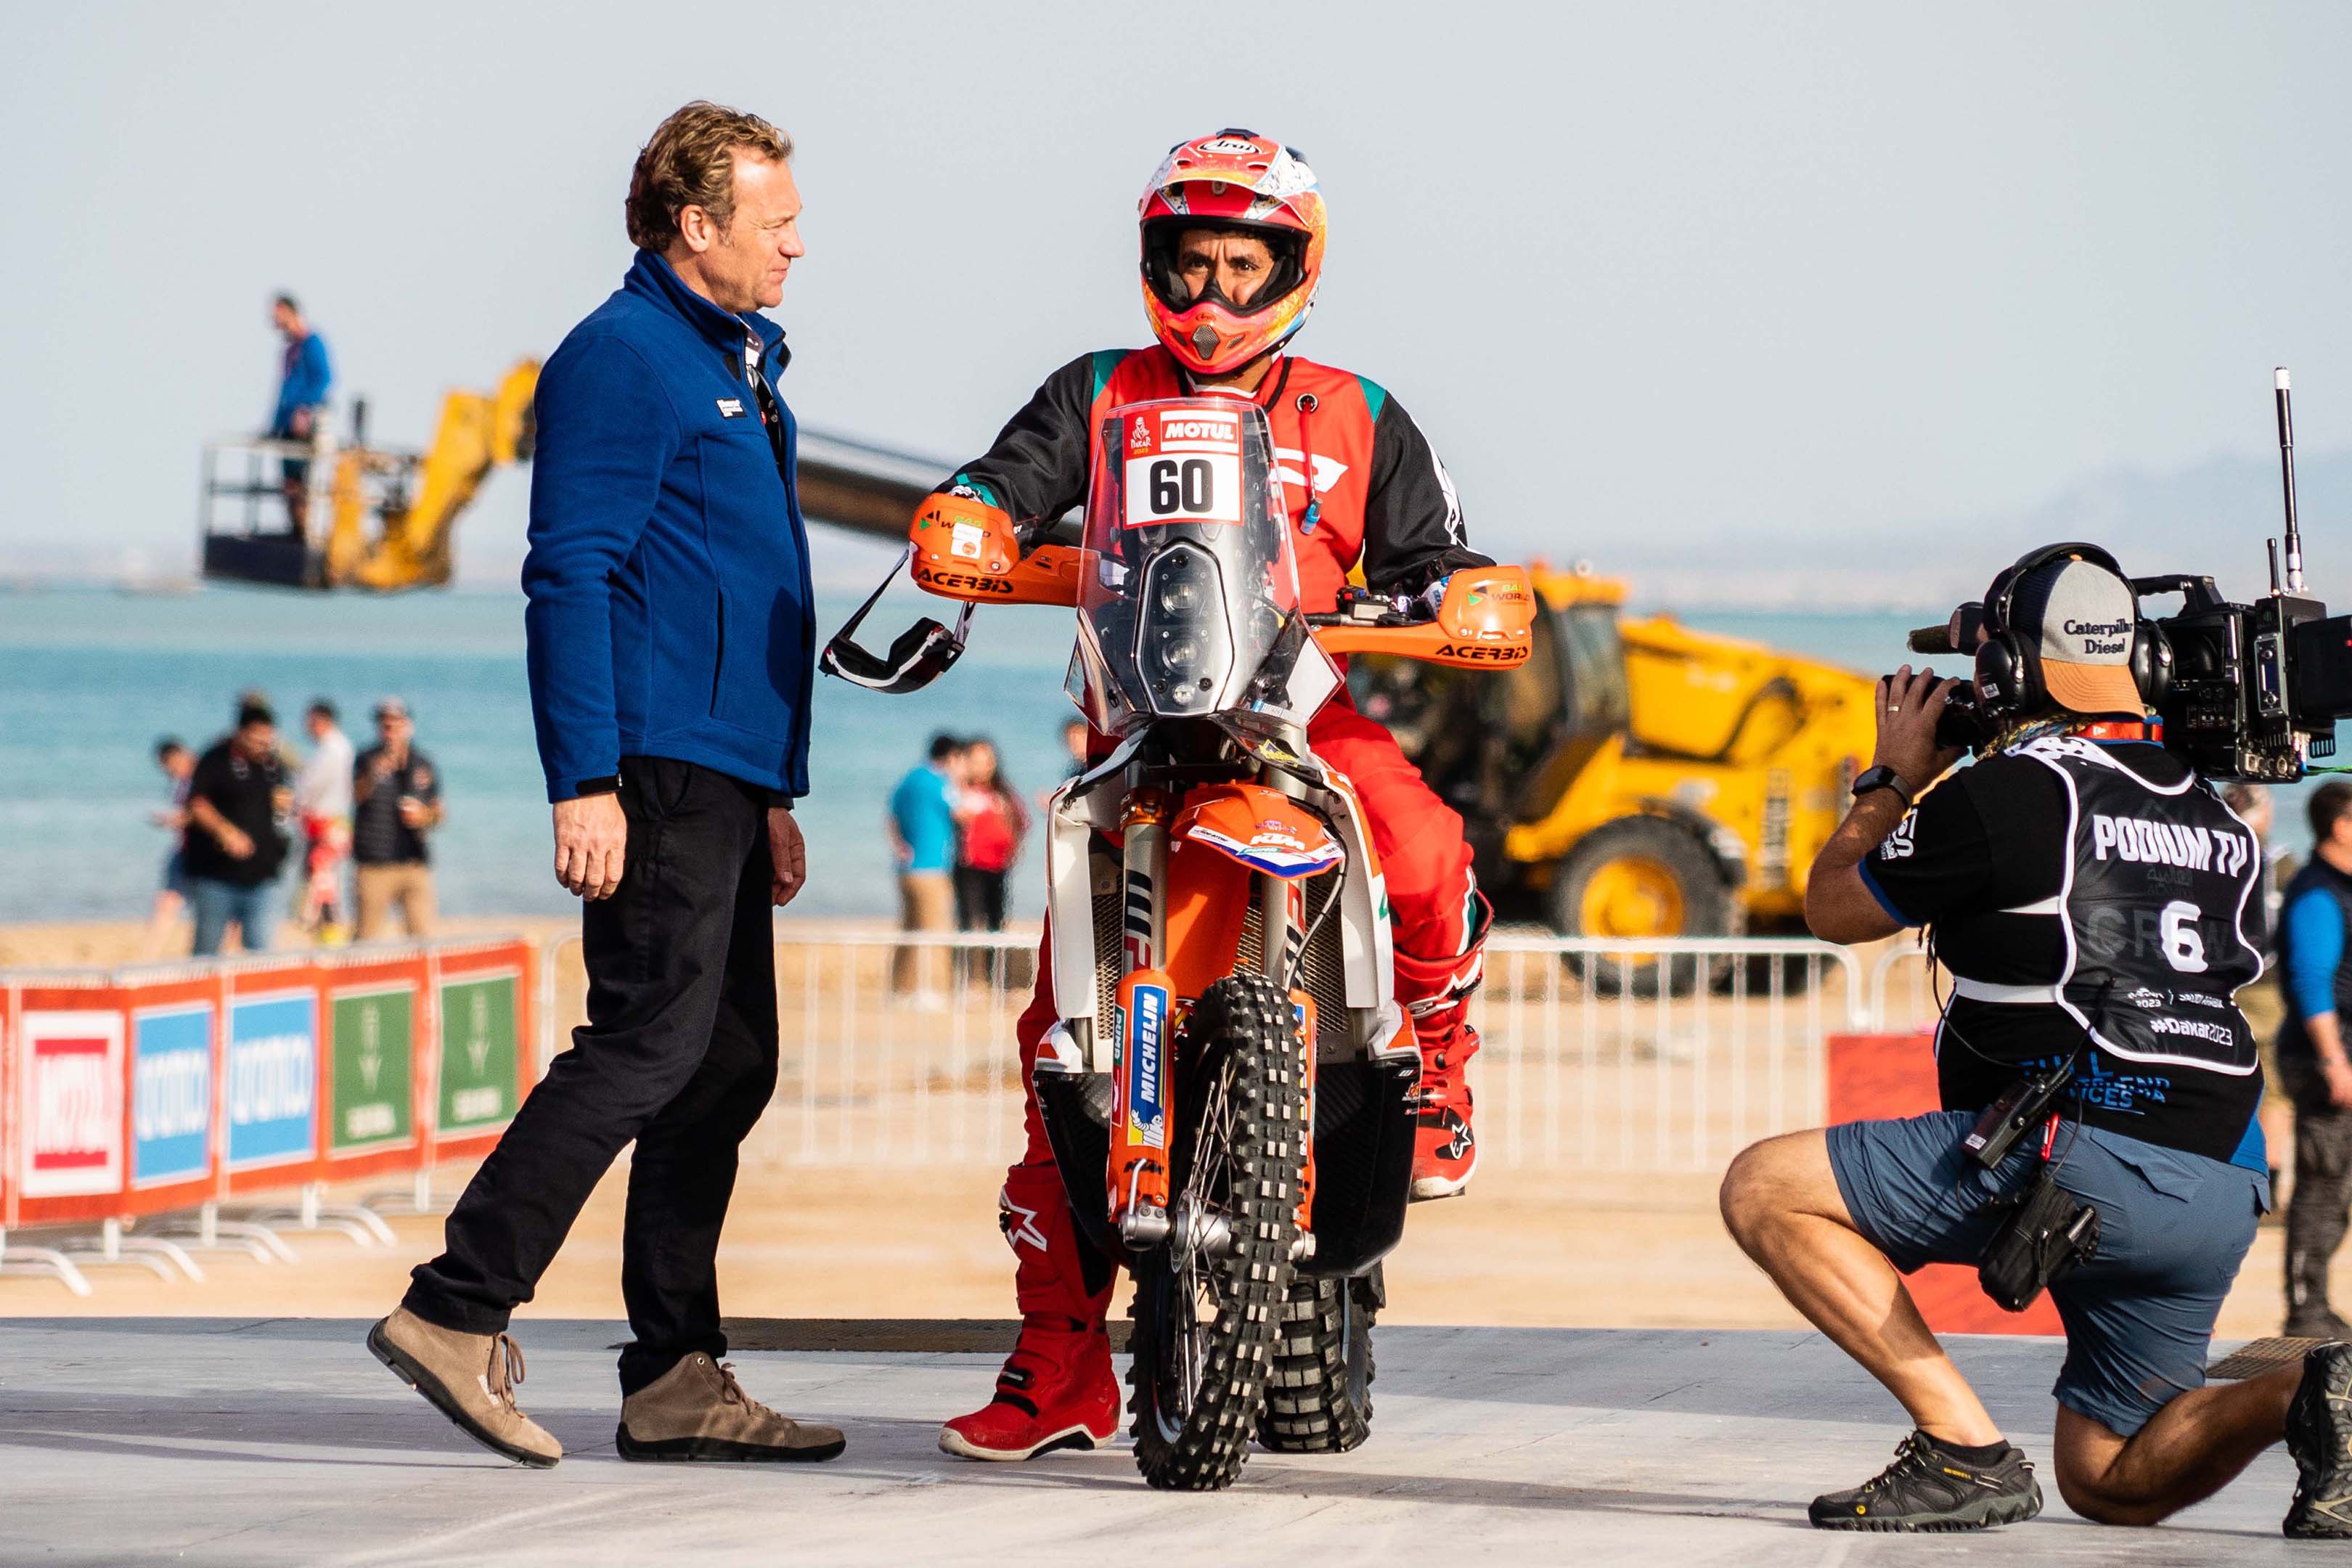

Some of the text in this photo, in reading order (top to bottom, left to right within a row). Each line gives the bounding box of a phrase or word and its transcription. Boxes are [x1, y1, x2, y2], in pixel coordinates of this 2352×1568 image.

[1165, 422, 1234, 439] MOTUL
[1150, 459, 1214, 515] 60
[2085, 638, 2126, 654] Diesel
[1249, 833, 1305, 851] KTM
[2093, 814, 2247, 878] PODIUM TV
[2160, 900, 2209, 973] 6
[2136, 998, 2162, 1008] 2023
[1140, 992, 1159, 1104] MICHELIN
